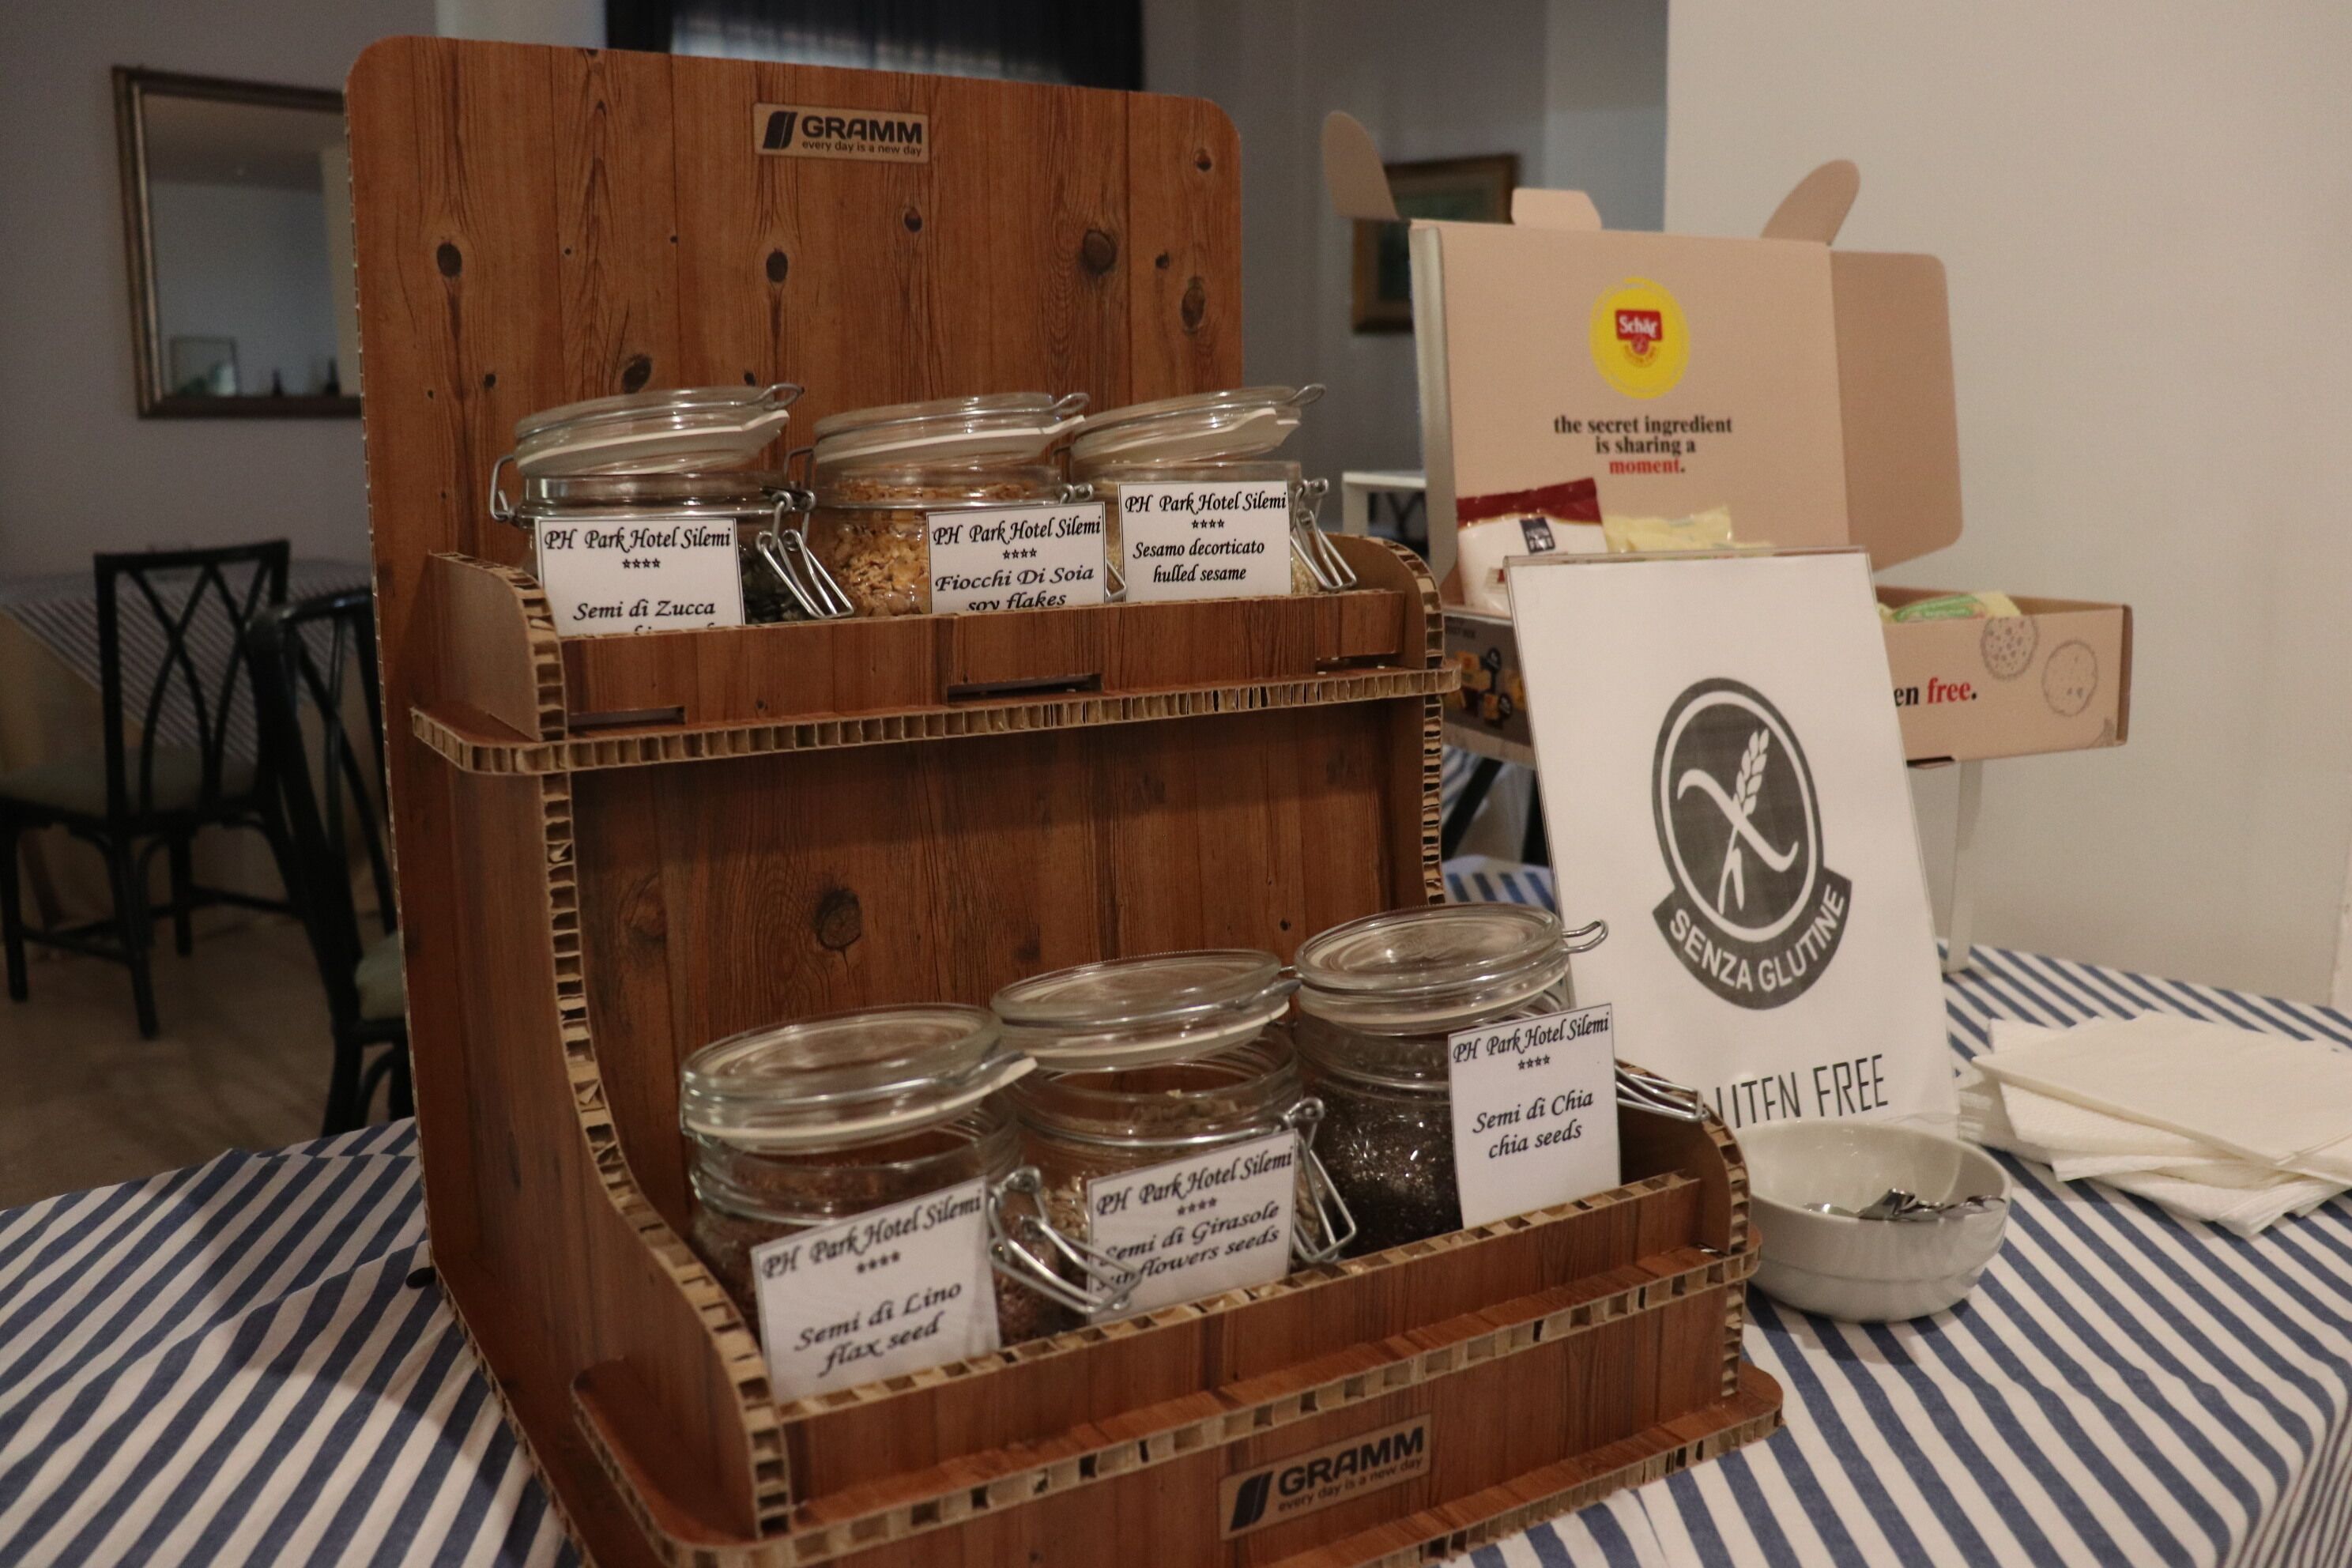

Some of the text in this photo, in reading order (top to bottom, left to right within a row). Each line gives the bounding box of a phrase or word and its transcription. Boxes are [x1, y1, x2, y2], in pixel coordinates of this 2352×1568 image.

[801, 115, 922, 144] GRAMM
[801, 141, 831, 152] every
[835, 141, 854, 153] day
[857, 142, 865, 153] is
[878, 145, 899, 154] new
[903, 145, 922, 156] day
[1554, 415, 1732, 436] the secret ingredient
[1595, 435, 1696, 457] is sharing a
[1609, 458, 1686, 474] moment.
[1125, 491, 1287, 514] PH Park Hotel Silemi
[544, 526, 732, 553] PH Park Hotel Silemi
[932, 515, 1101, 545] PH Park Hotel Silemi
[1133, 538, 1265, 559] Sesamo decorticato
[935, 564, 1094, 592] Fiocchi Di Soia
[1153, 564, 1246, 583] hulled sesame
[573, 599, 715, 620] Semi di Zucca
[1006, 590, 1067, 609] flakes
[1927, 677, 1977, 705] free.
[1670, 883, 1845, 992] SENZA GLUTINE
[1453, 1012, 1610, 1063] PH Park Hotel Silemi
[1812, 1054, 1888, 1118] FREE
[1472, 1089, 1594, 1134] Semi di Chia
[1488, 1119, 1582, 1159] chia seeds
[1095, 1146, 1294, 1217] PH Park Hotel Silemi
[762, 1188, 983, 1279] PH Park Hotel Silemi
[1161, 1226, 1185, 1249] di
[1192, 1201, 1280, 1246] Girasole
[1223, 1223, 1280, 1255] seeds
[793, 1282, 963, 1352] Semi di Lino
[816, 1310, 946, 1378] flax seed
[1278, 1426, 1425, 1496] GRAMM
[1277, 1458, 1423, 1513] every day is a new day
